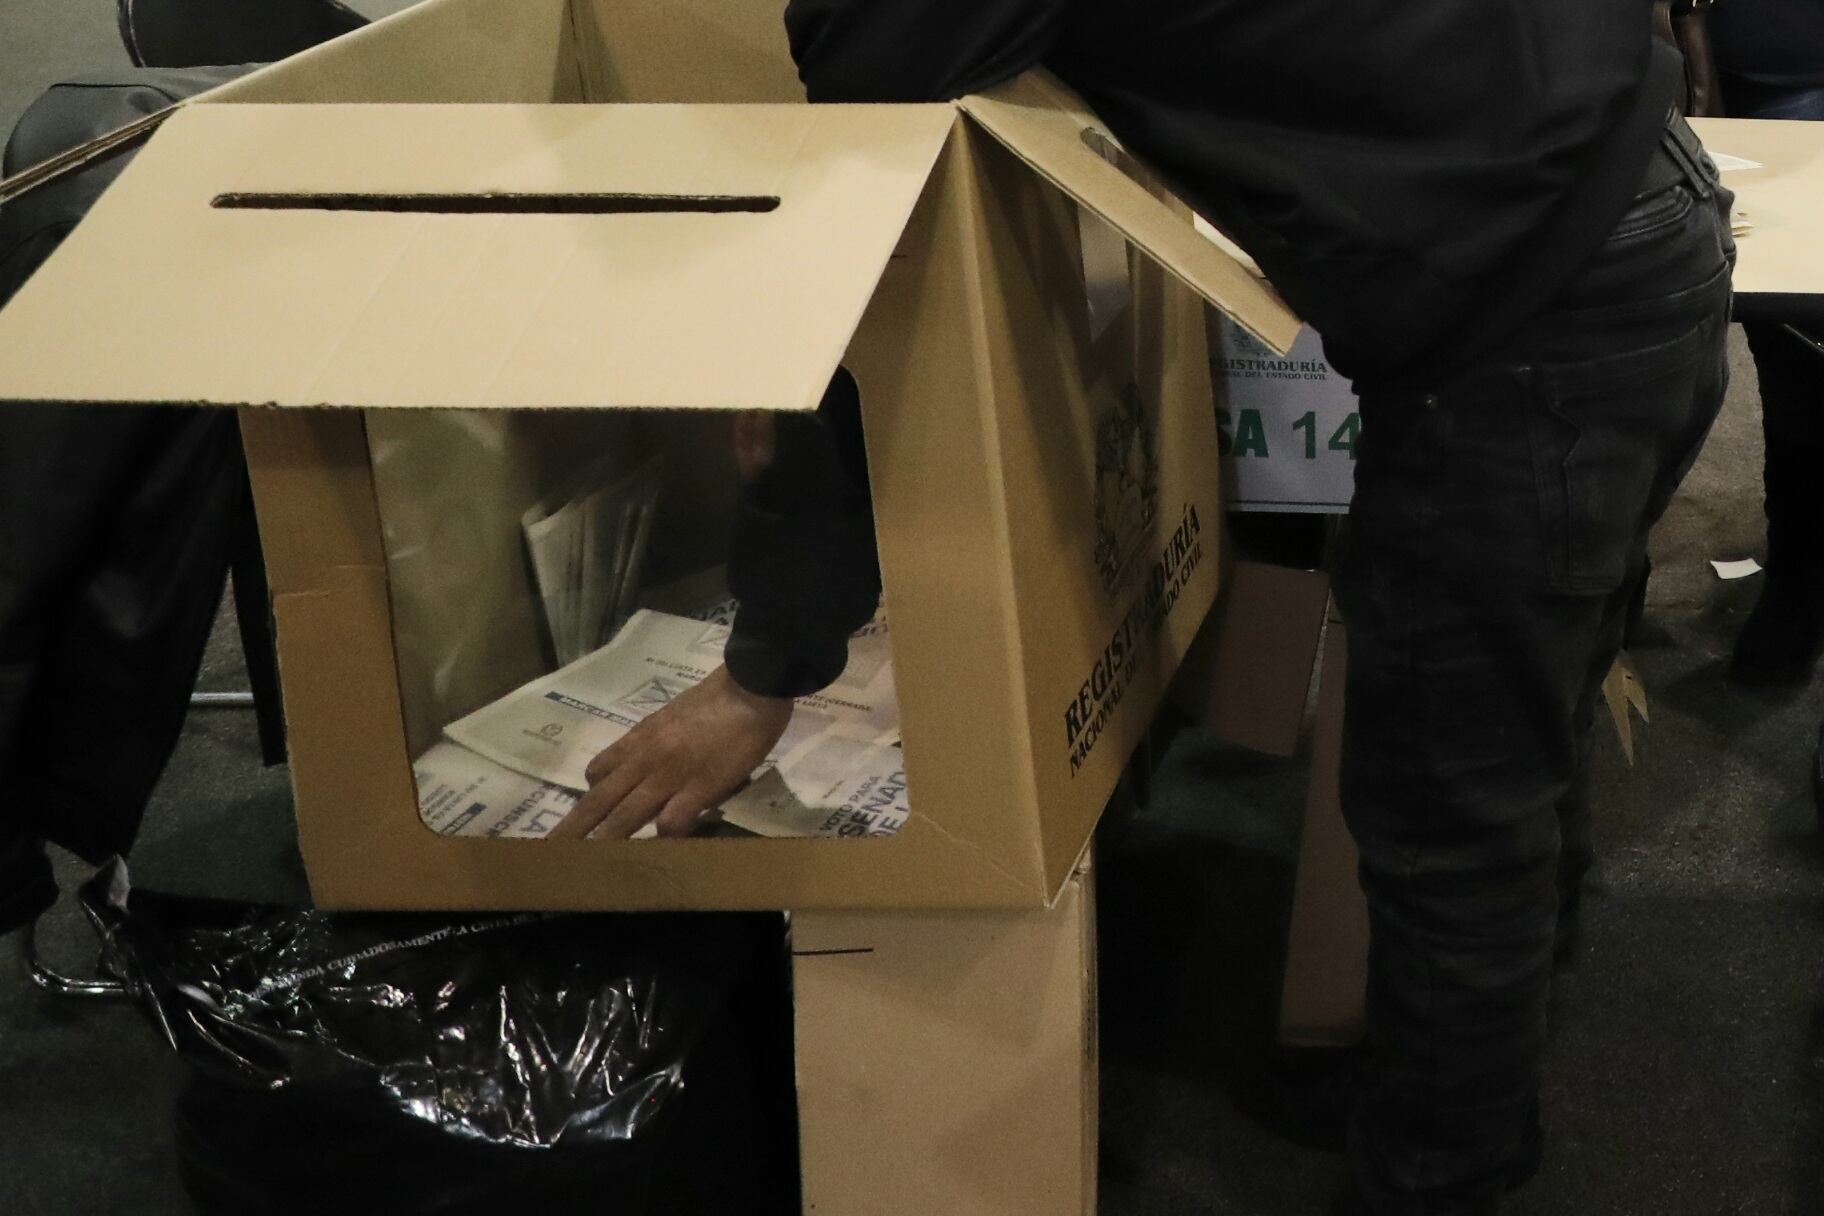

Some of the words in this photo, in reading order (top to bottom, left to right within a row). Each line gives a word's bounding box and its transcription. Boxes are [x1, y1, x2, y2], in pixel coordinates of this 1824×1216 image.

[1266, 372, 1301, 380] ESTADO
[1215, 408, 1269, 458] SA
[1064, 502, 1201, 749] REGISTDURÍA
[1071, 687, 1123, 779] NACIONAL
[820, 804, 854, 831] VOTO
[838, 771, 905, 837] SENAD
